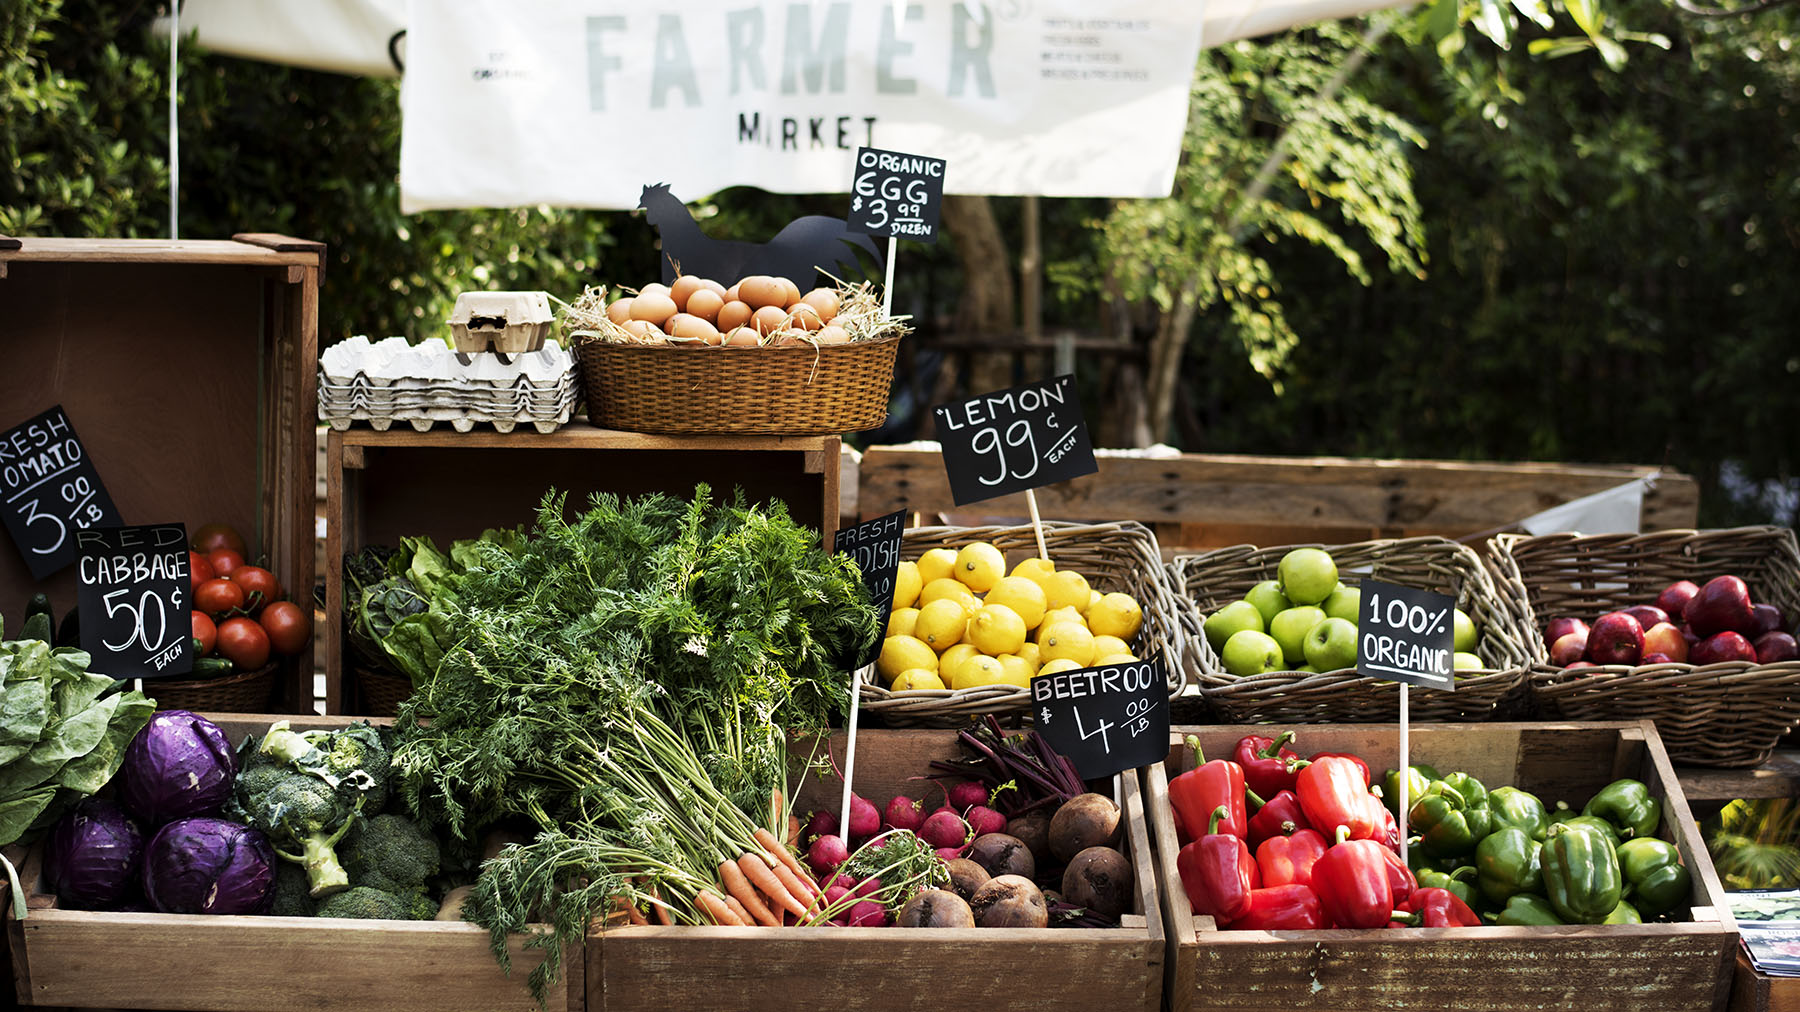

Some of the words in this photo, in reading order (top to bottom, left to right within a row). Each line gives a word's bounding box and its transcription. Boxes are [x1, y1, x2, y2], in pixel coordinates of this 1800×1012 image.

[585, 2, 997, 112] FARMER
[738, 112, 879, 151] MRKET
[860, 151, 942, 177] ORGANIC
[855, 171, 928, 205] EGG
[890, 222, 932, 236] DOZEN
[0, 413, 69, 463] RESH
[1048, 435, 1078, 465] EACH
[0, 438, 82, 494] OMATO
[17, 499, 67, 554] 3
[76, 503, 103, 529] LB
[835, 515, 899, 549] FRESH
[76, 527, 185, 549] RED
[848, 537, 901, 573] DISH
[80, 551, 188, 585] CABBAGE
[1369, 593, 1448, 636] 100%
[154, 644, 183, 671] EACH
[1363, 633, 1450, 675] ORGANIC
[1034, 656, 1159, 702] BEETROOT
[1130, 717, 1150, 738] LB
